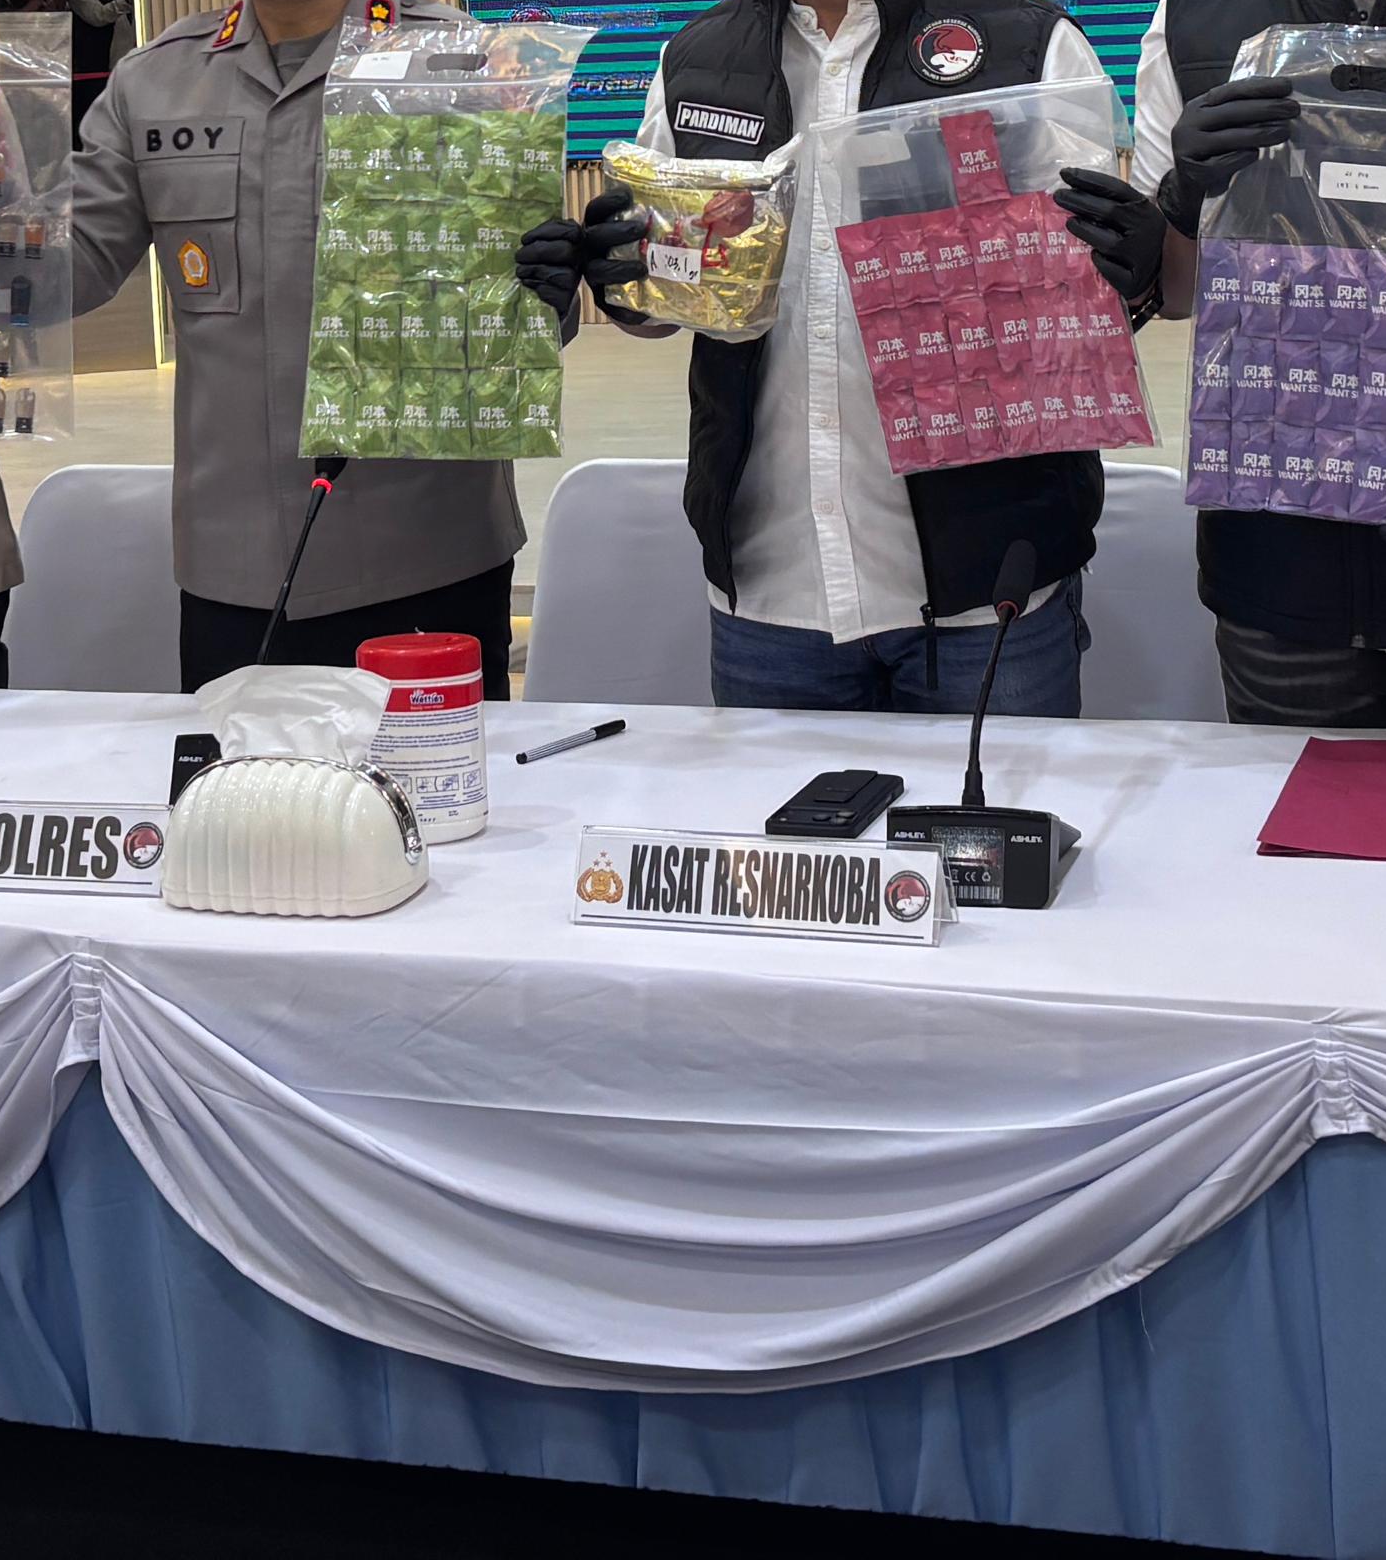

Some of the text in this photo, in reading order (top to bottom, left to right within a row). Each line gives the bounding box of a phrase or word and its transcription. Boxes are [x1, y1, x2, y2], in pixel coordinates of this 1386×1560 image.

[680, 108, 761, 140] PARDIMAN
[146, 127, 223, 152] BOY
[1358, 479, 1385, 491] WANT
[627, 844, 881, 925] KASAT RESNARKOBA
